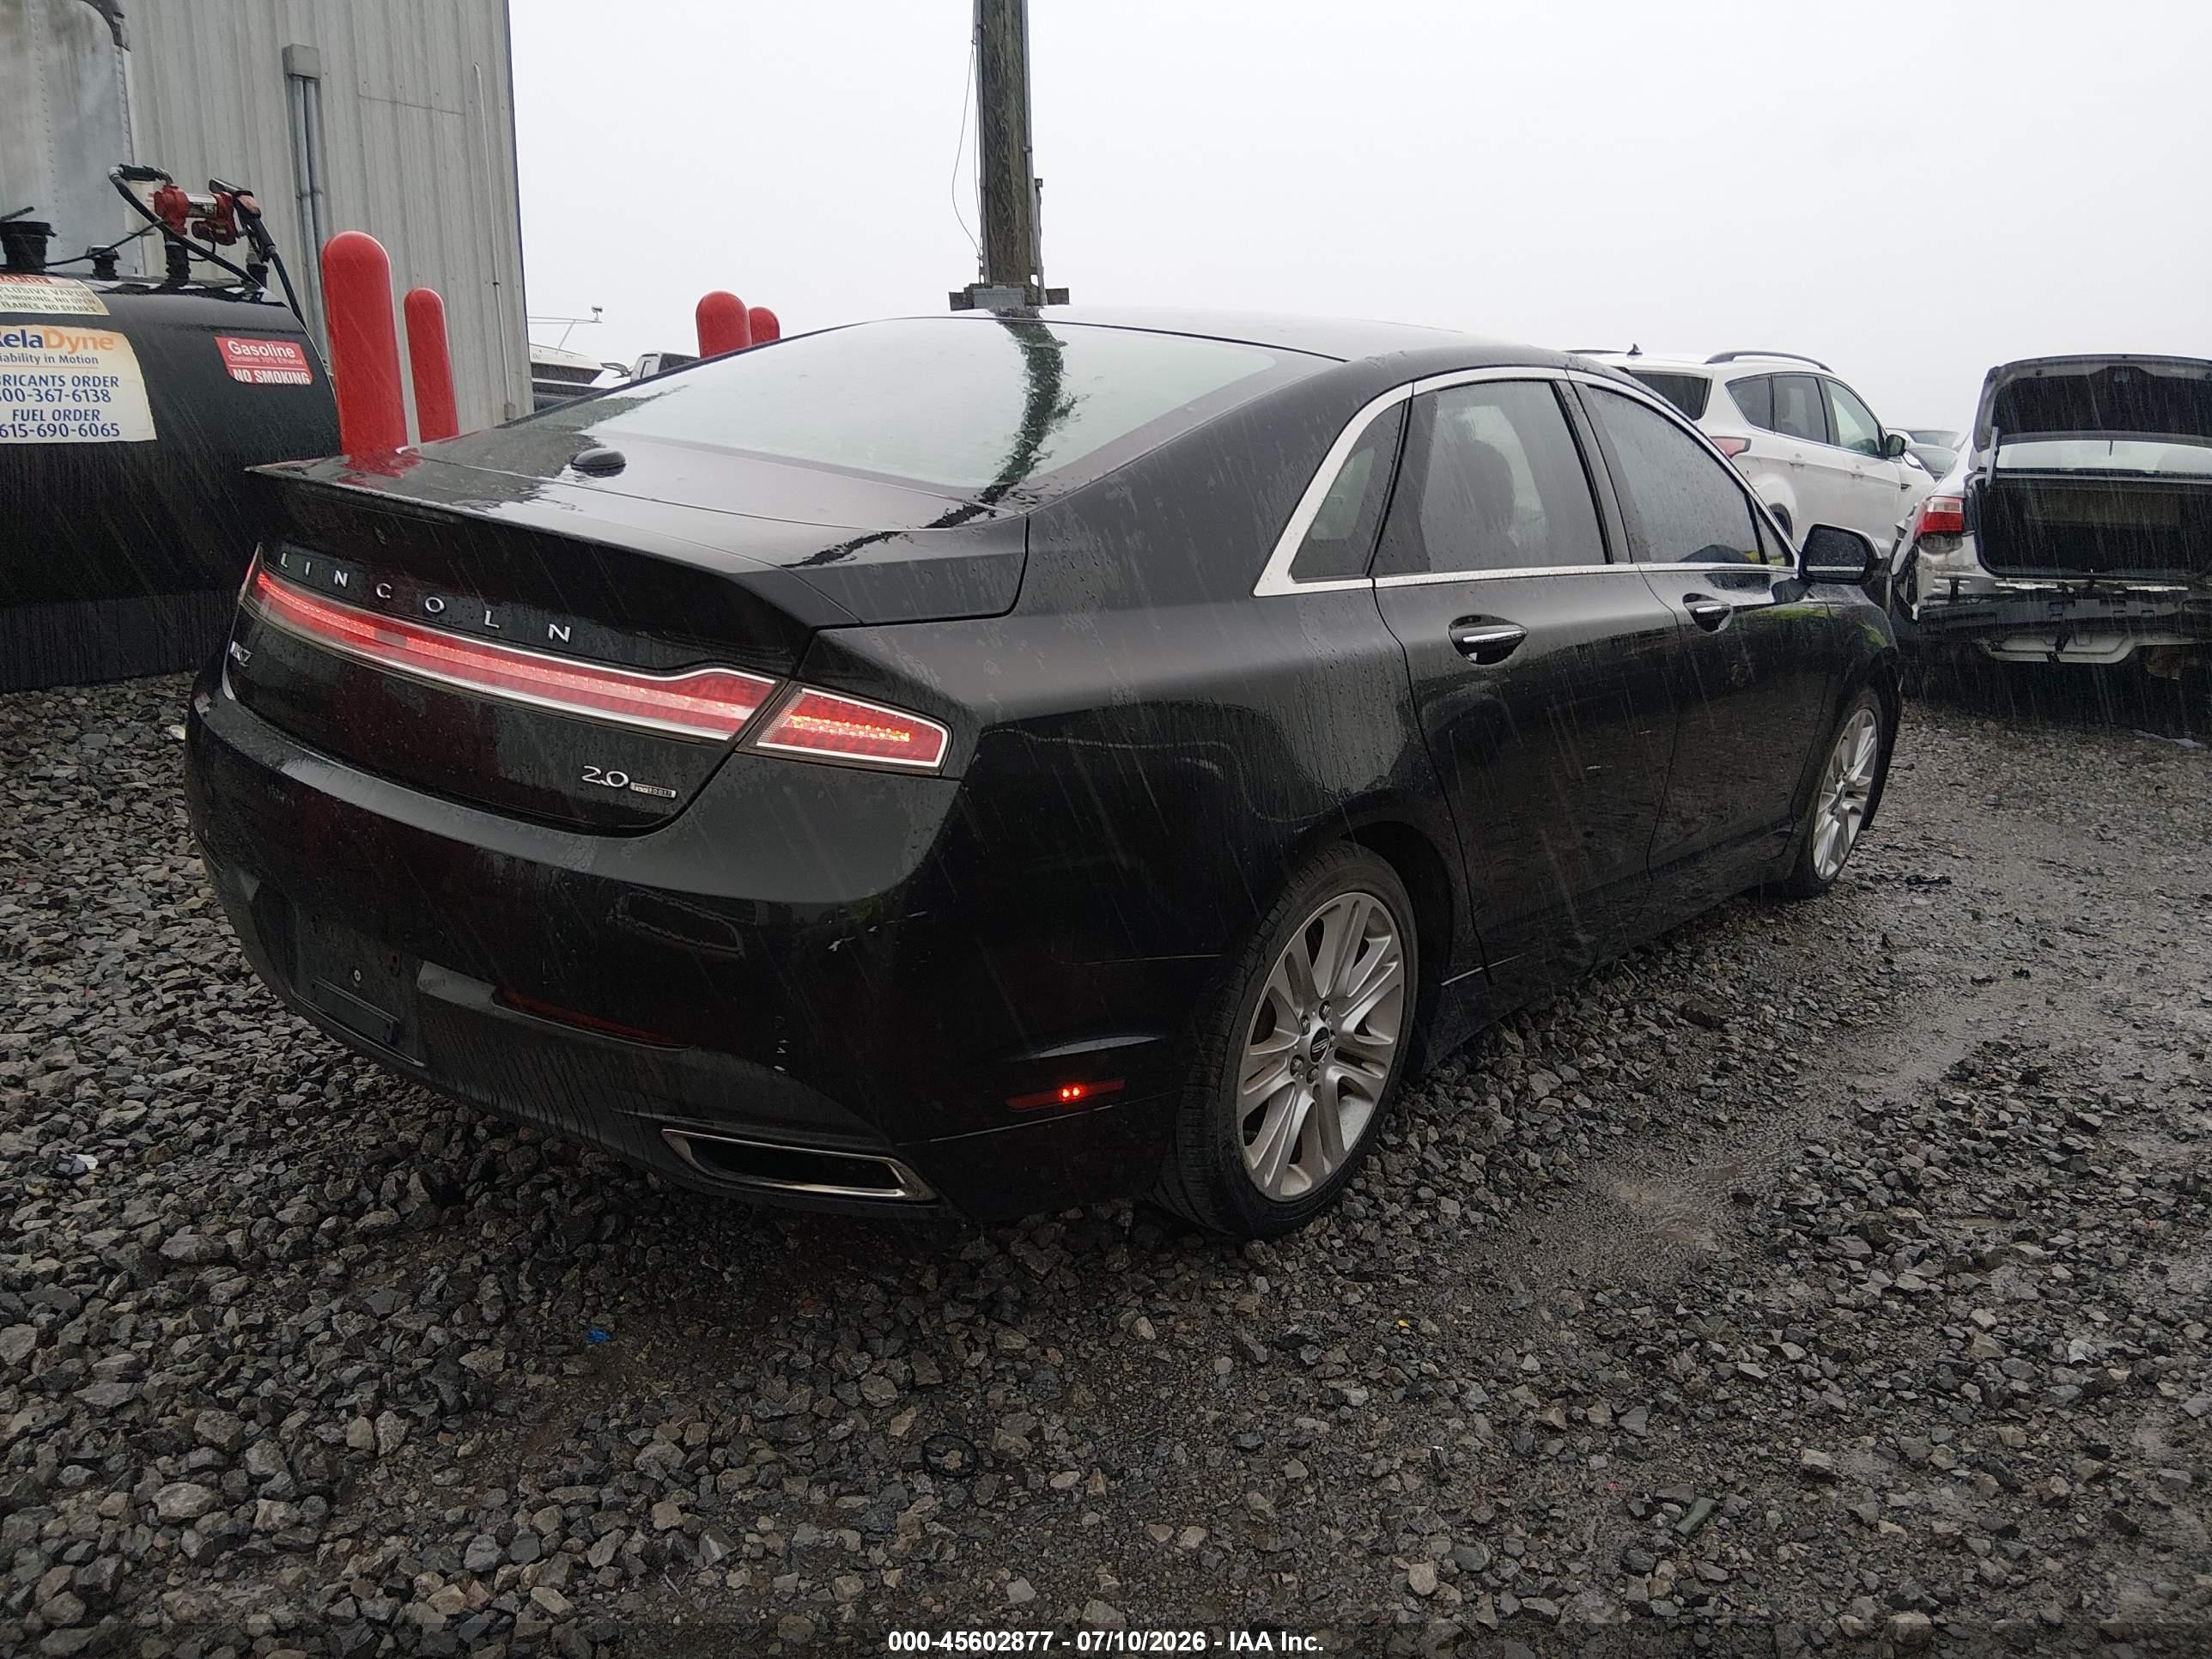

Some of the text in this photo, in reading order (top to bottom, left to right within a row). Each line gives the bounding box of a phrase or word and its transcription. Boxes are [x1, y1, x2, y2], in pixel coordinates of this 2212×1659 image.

[227, 340, 296, 358] Gasoline
[45, 354, 56, 364] in
[59, 354, 99, 364] Motion
[71, 375, 119, 387] ORDER
[233, 368, 311, 385] NO SMOKING
[12, 409, 100, 422] FUEL ORDER
[280, 552, 571, 643] LINCOLN
